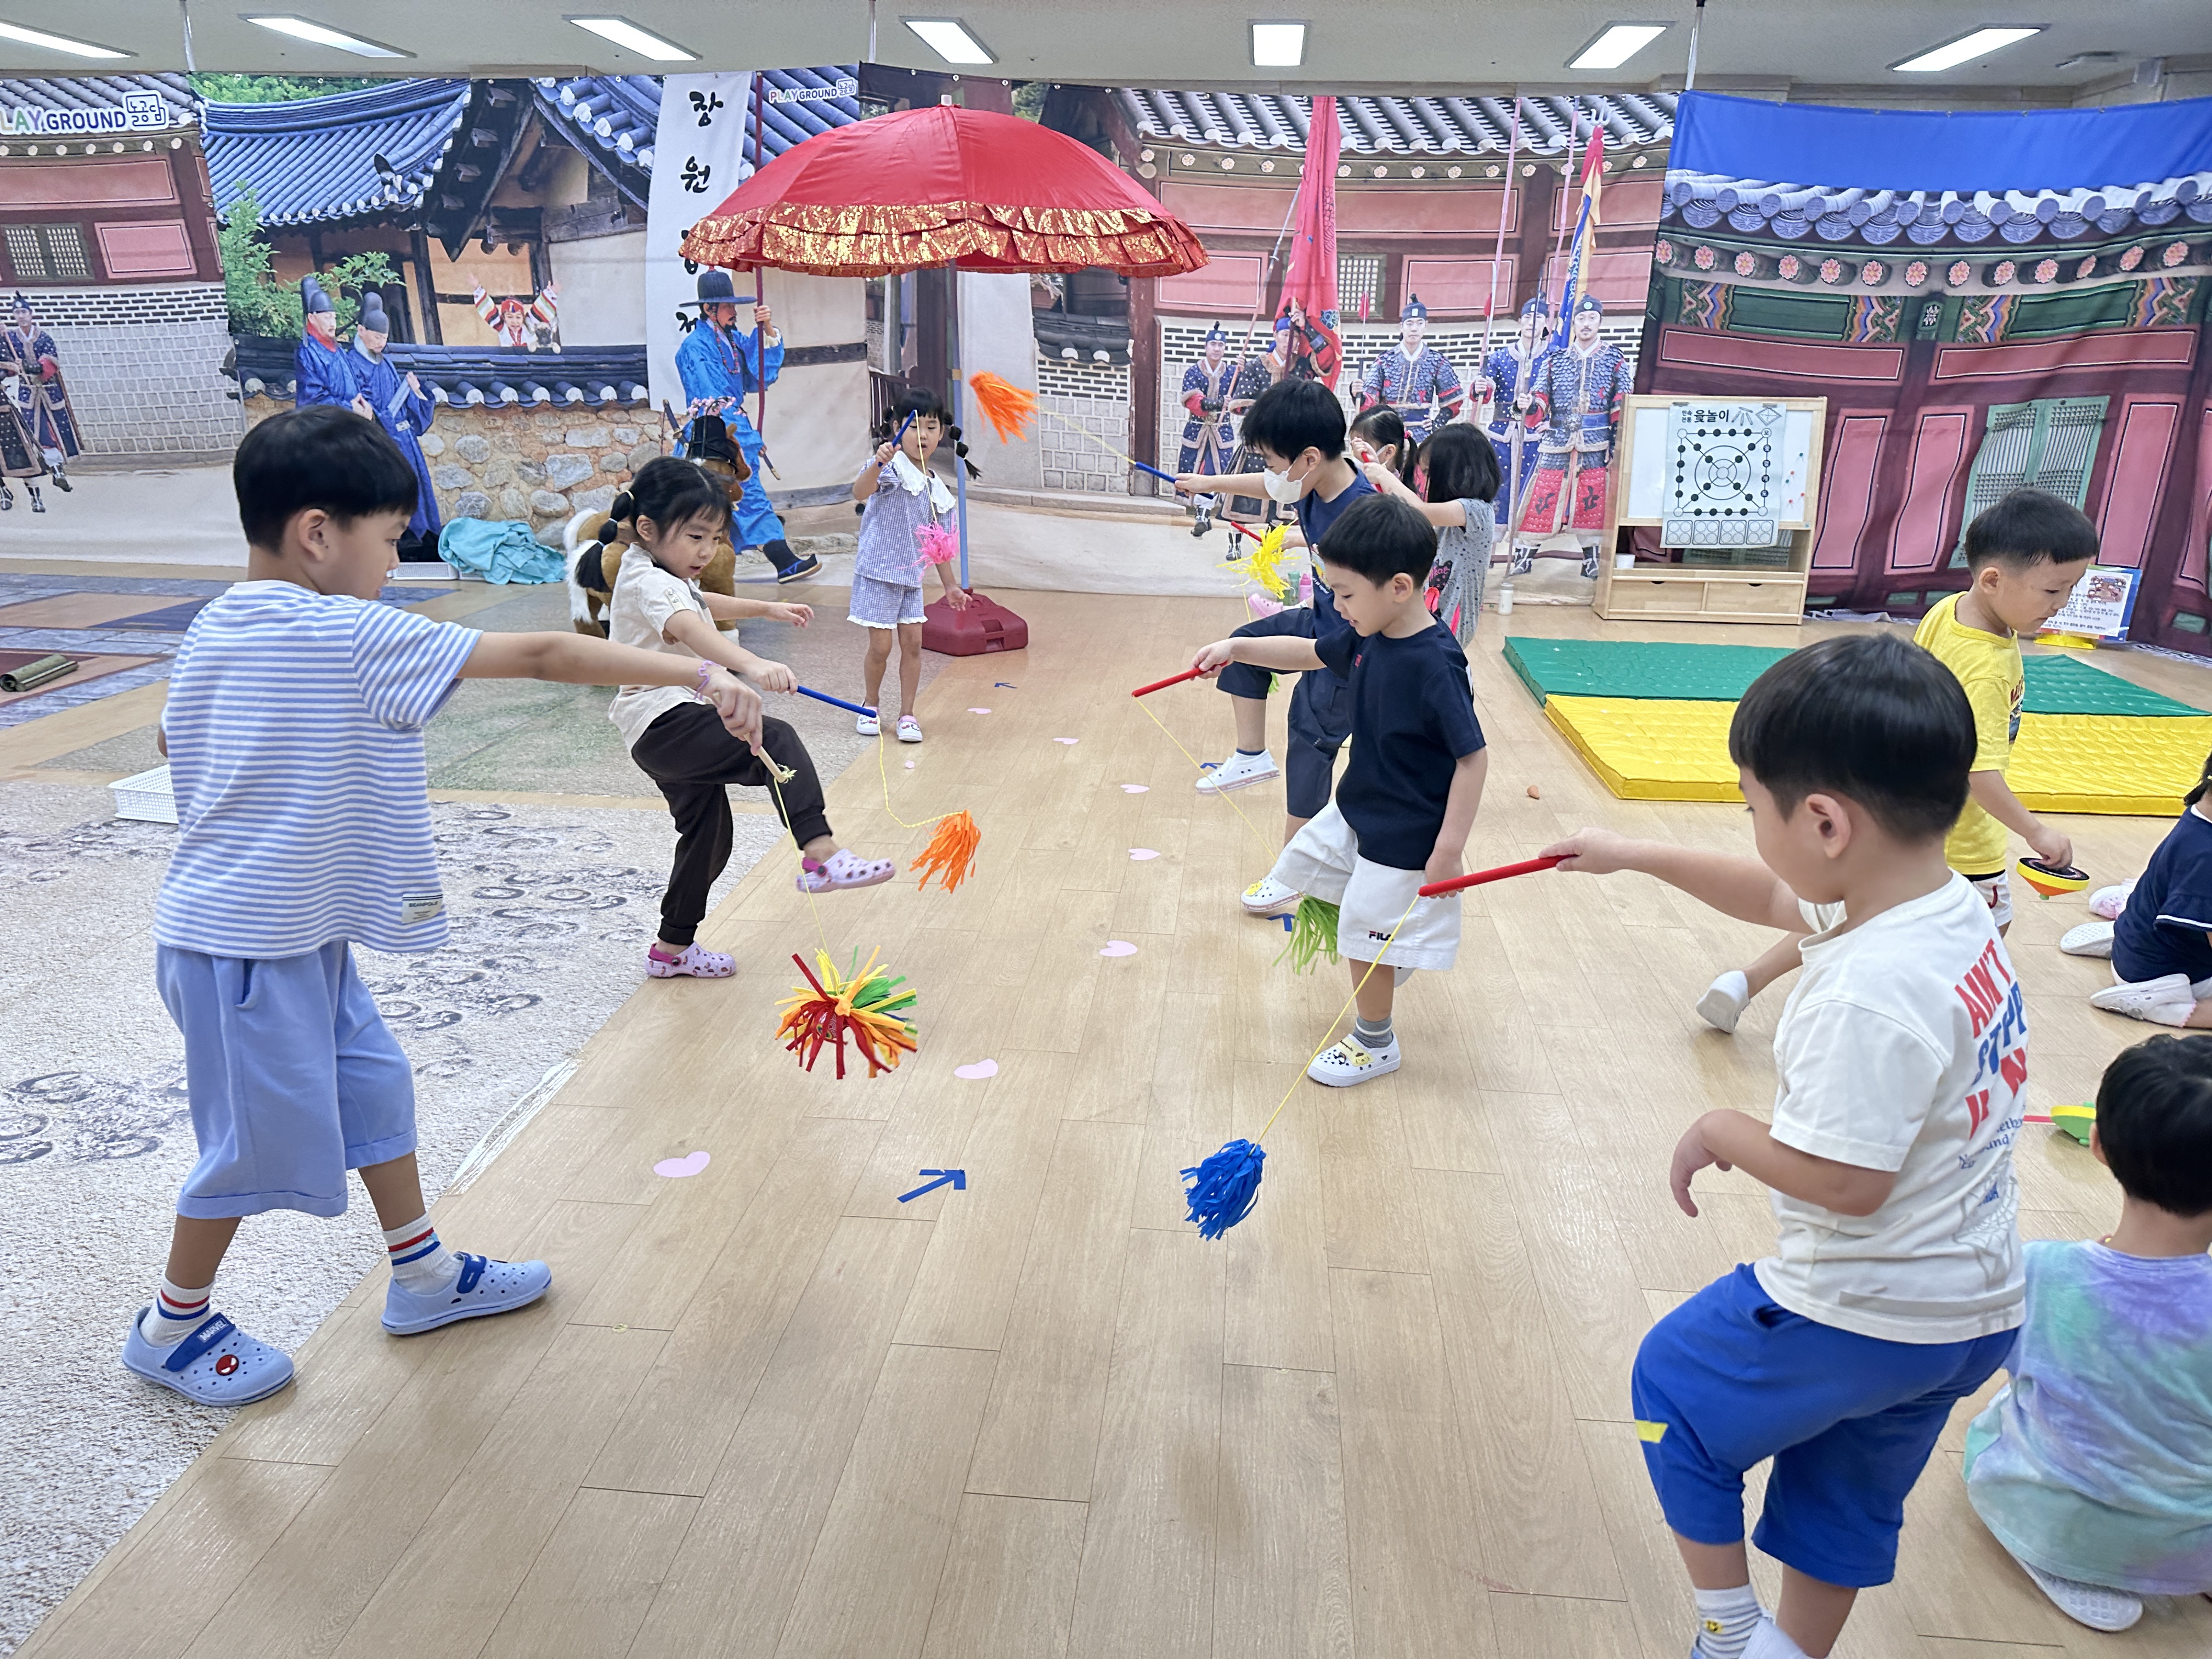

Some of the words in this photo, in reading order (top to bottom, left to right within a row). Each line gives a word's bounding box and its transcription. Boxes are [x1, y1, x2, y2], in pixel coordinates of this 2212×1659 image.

[1694, 409, 1729, 422] 윷놀이
[1954, 938, 2011, 1039] AIN'T
[199, 1319, 227, 1341] MARVEL
